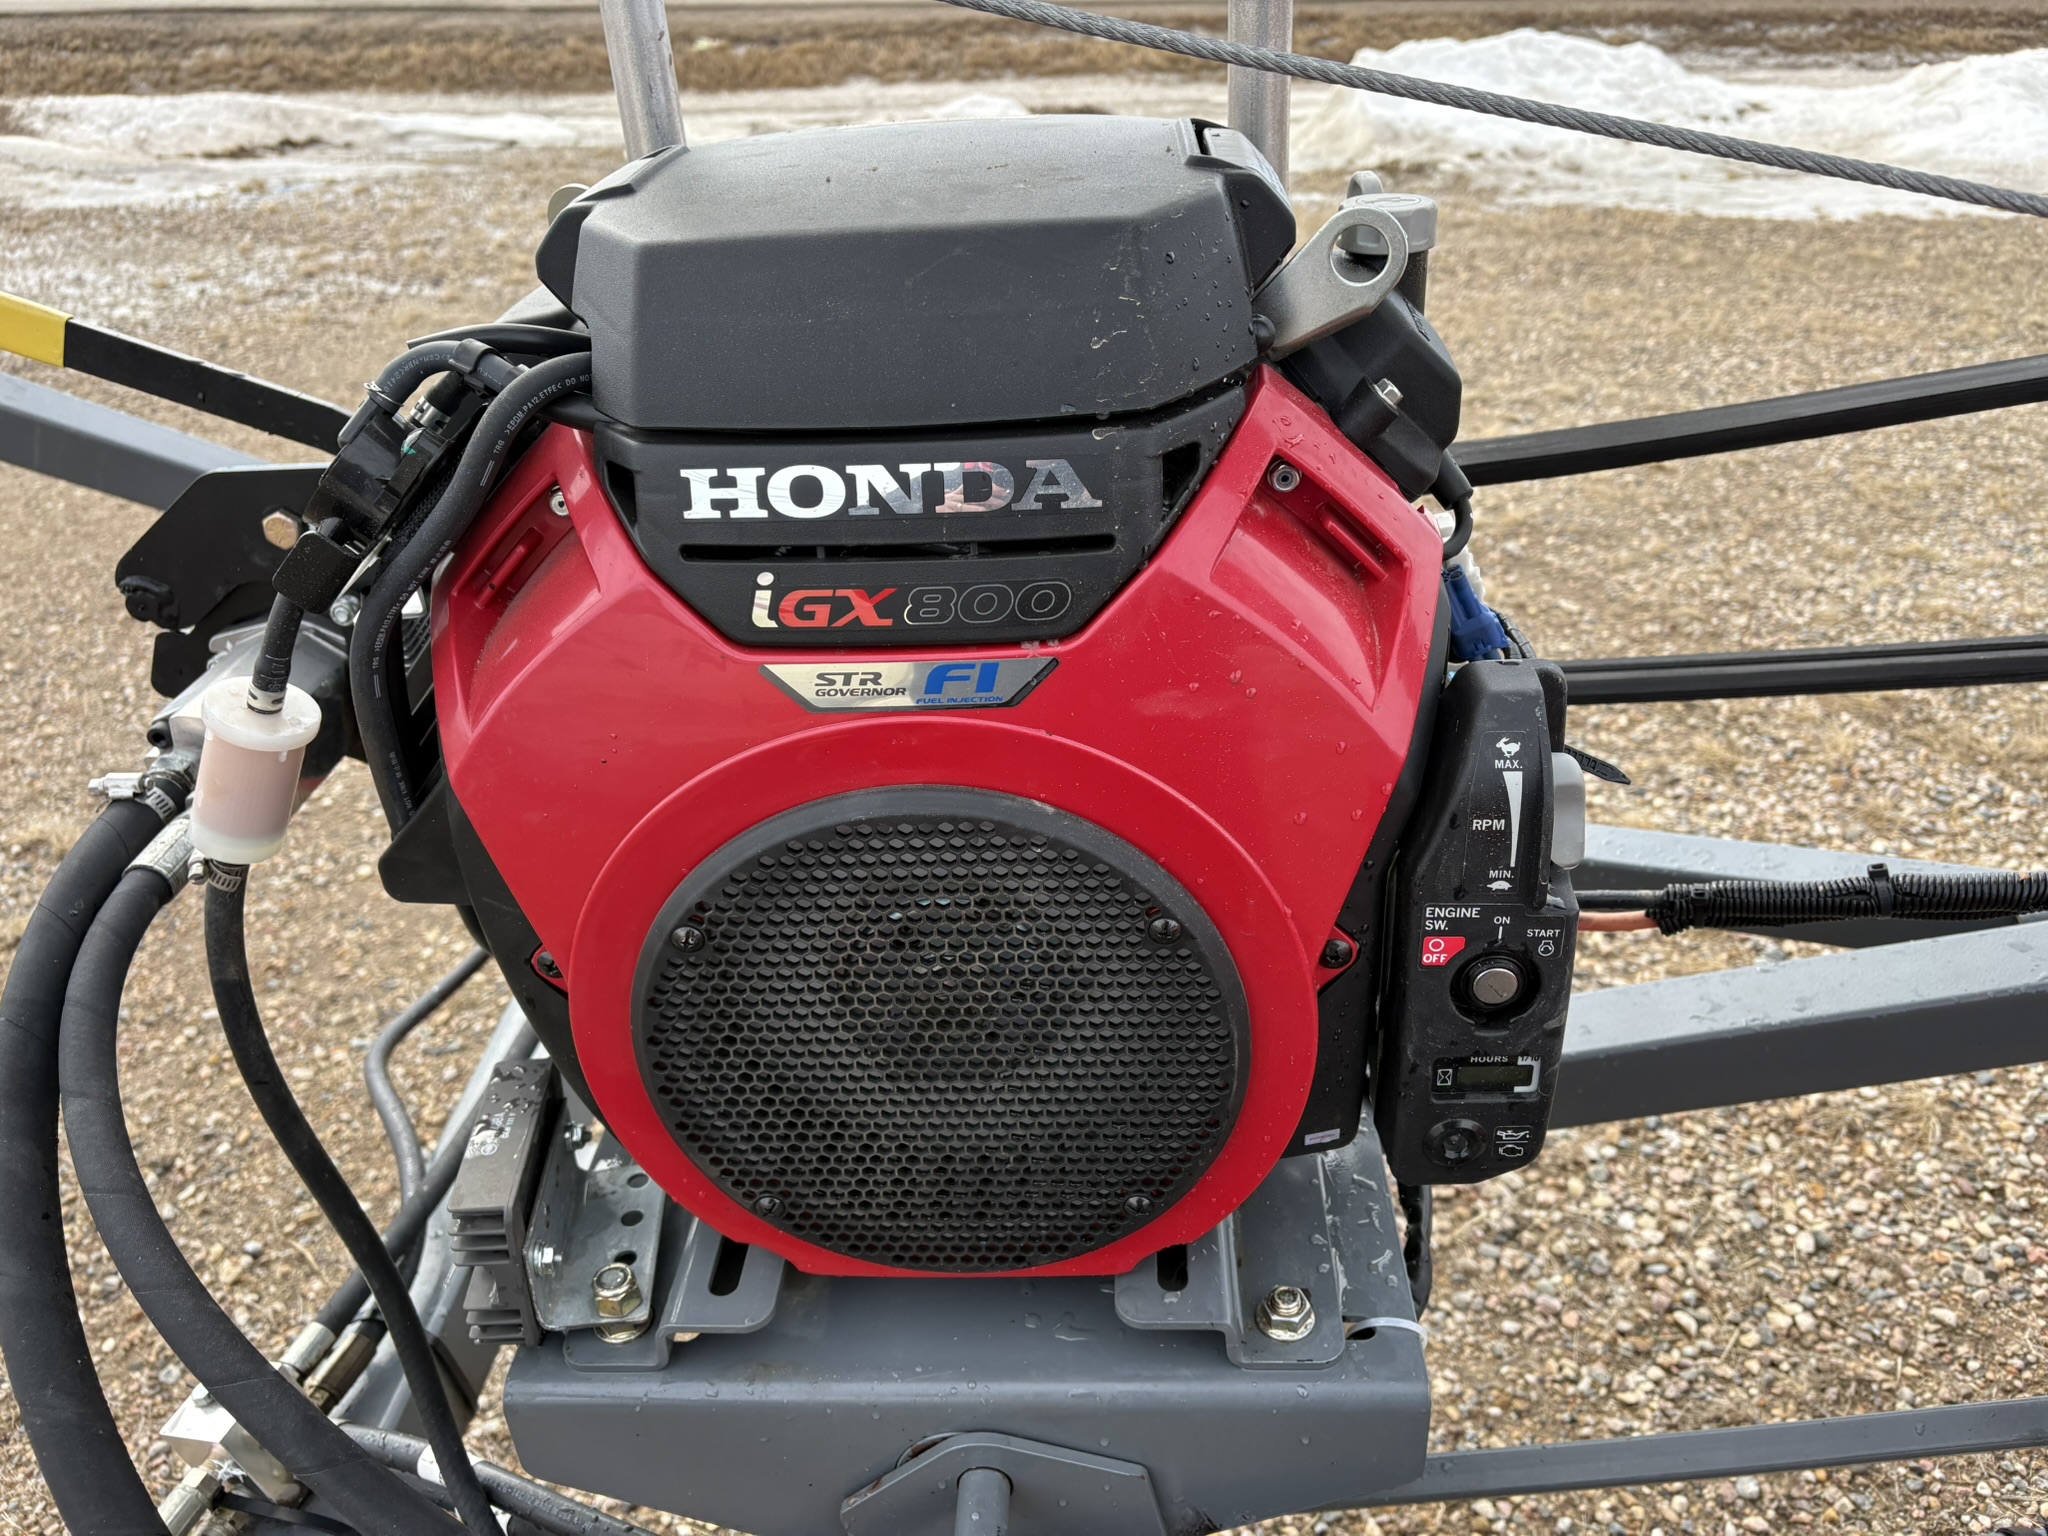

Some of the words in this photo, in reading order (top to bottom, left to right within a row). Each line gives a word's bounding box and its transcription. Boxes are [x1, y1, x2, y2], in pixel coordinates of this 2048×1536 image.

[565, 378, 576, 387] DO
[679, 458, 1103, 520] HONDA
[814, 671, 883, 687] STR
[923, 662, 1000, 695] FI
[815, 686, 906, 698] GOVERNOR
[946, 695, 1003, 704] INJECTION
[1494, 759, 1523, 769] MAX.
[1472, 819, 1506, 831] RPM
[1488, 869, 1514, 879] MIN.
[1425, 907, 1481, 919] ENGINE
[1424, 919, 1449, 931] SW.
[1493, 916, 1511, 925] ON
[1526, 929, 1561, 938] START
[1422, 953, 1448, 964] OFF
